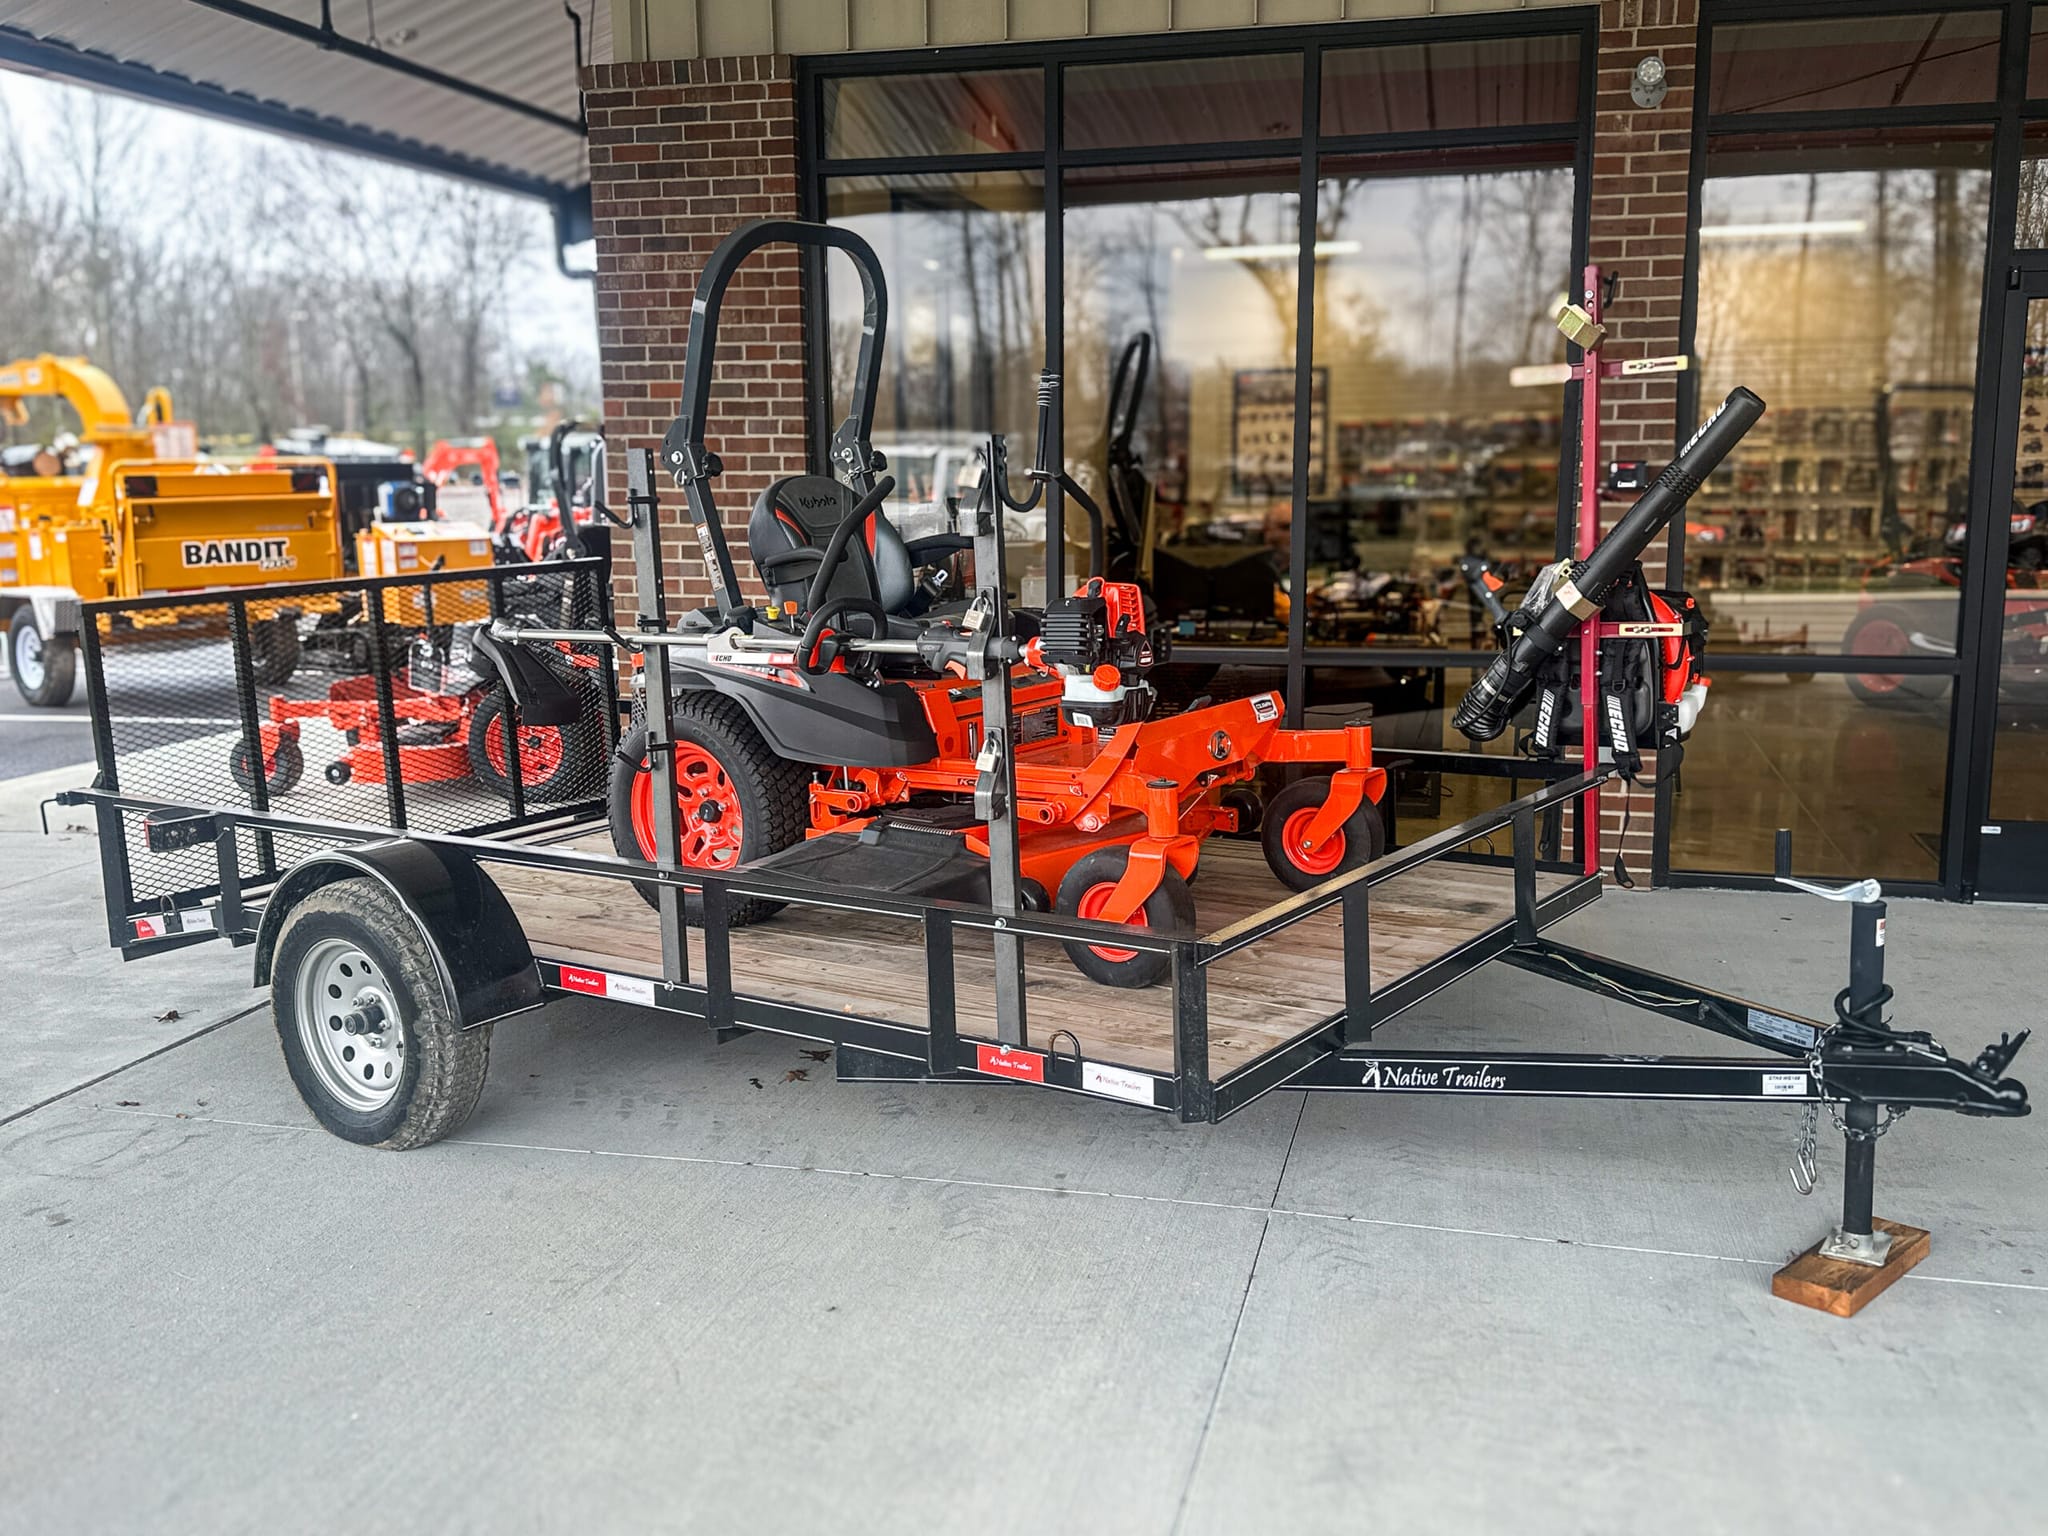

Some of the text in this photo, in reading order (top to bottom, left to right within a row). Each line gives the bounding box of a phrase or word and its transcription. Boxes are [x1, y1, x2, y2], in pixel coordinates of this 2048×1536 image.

[799, 495, 837, 509] Kubota
[184, 540, 287, 565] BANDIT
[714, 654, 733, 662] ECHO
[1535, 697, 1555, 748] ECHO
[1607, 702, 1630, 753] ECHO
[1383, 1064, 1506, 1089] Native Trailers
